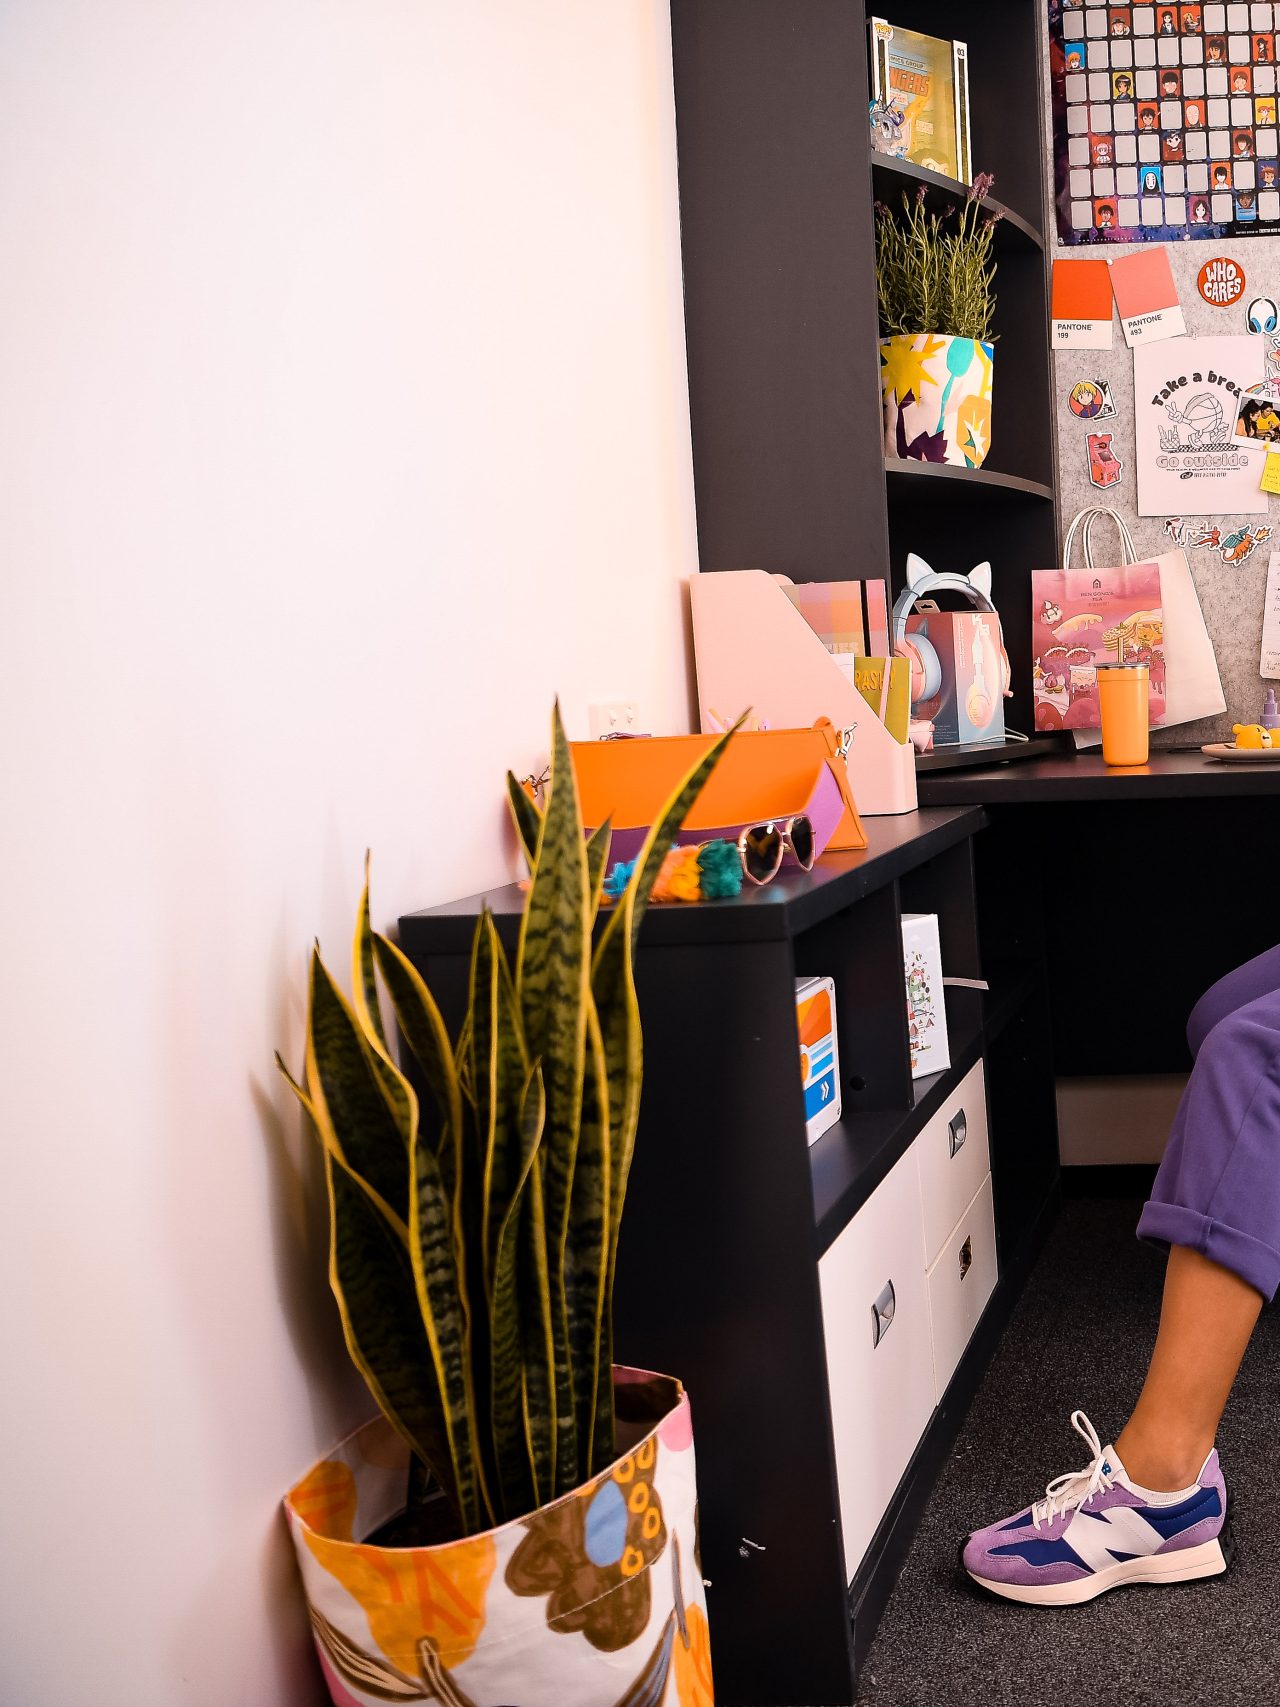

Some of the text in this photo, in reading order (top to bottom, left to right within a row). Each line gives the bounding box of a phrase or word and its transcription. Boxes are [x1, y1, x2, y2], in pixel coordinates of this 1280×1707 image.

[1205, 261, 1237, 282] WHO
[1203, 277, 1242, 302] CARES
[1057, 323, 1092, 331] PANTONE
[1127, 314, 1163, 328] PANTONE
[1151, 376, 1188, 406] Take
[1192, 372, 1203, 383] a
[1156, 453, 1249, 468] Go outside
